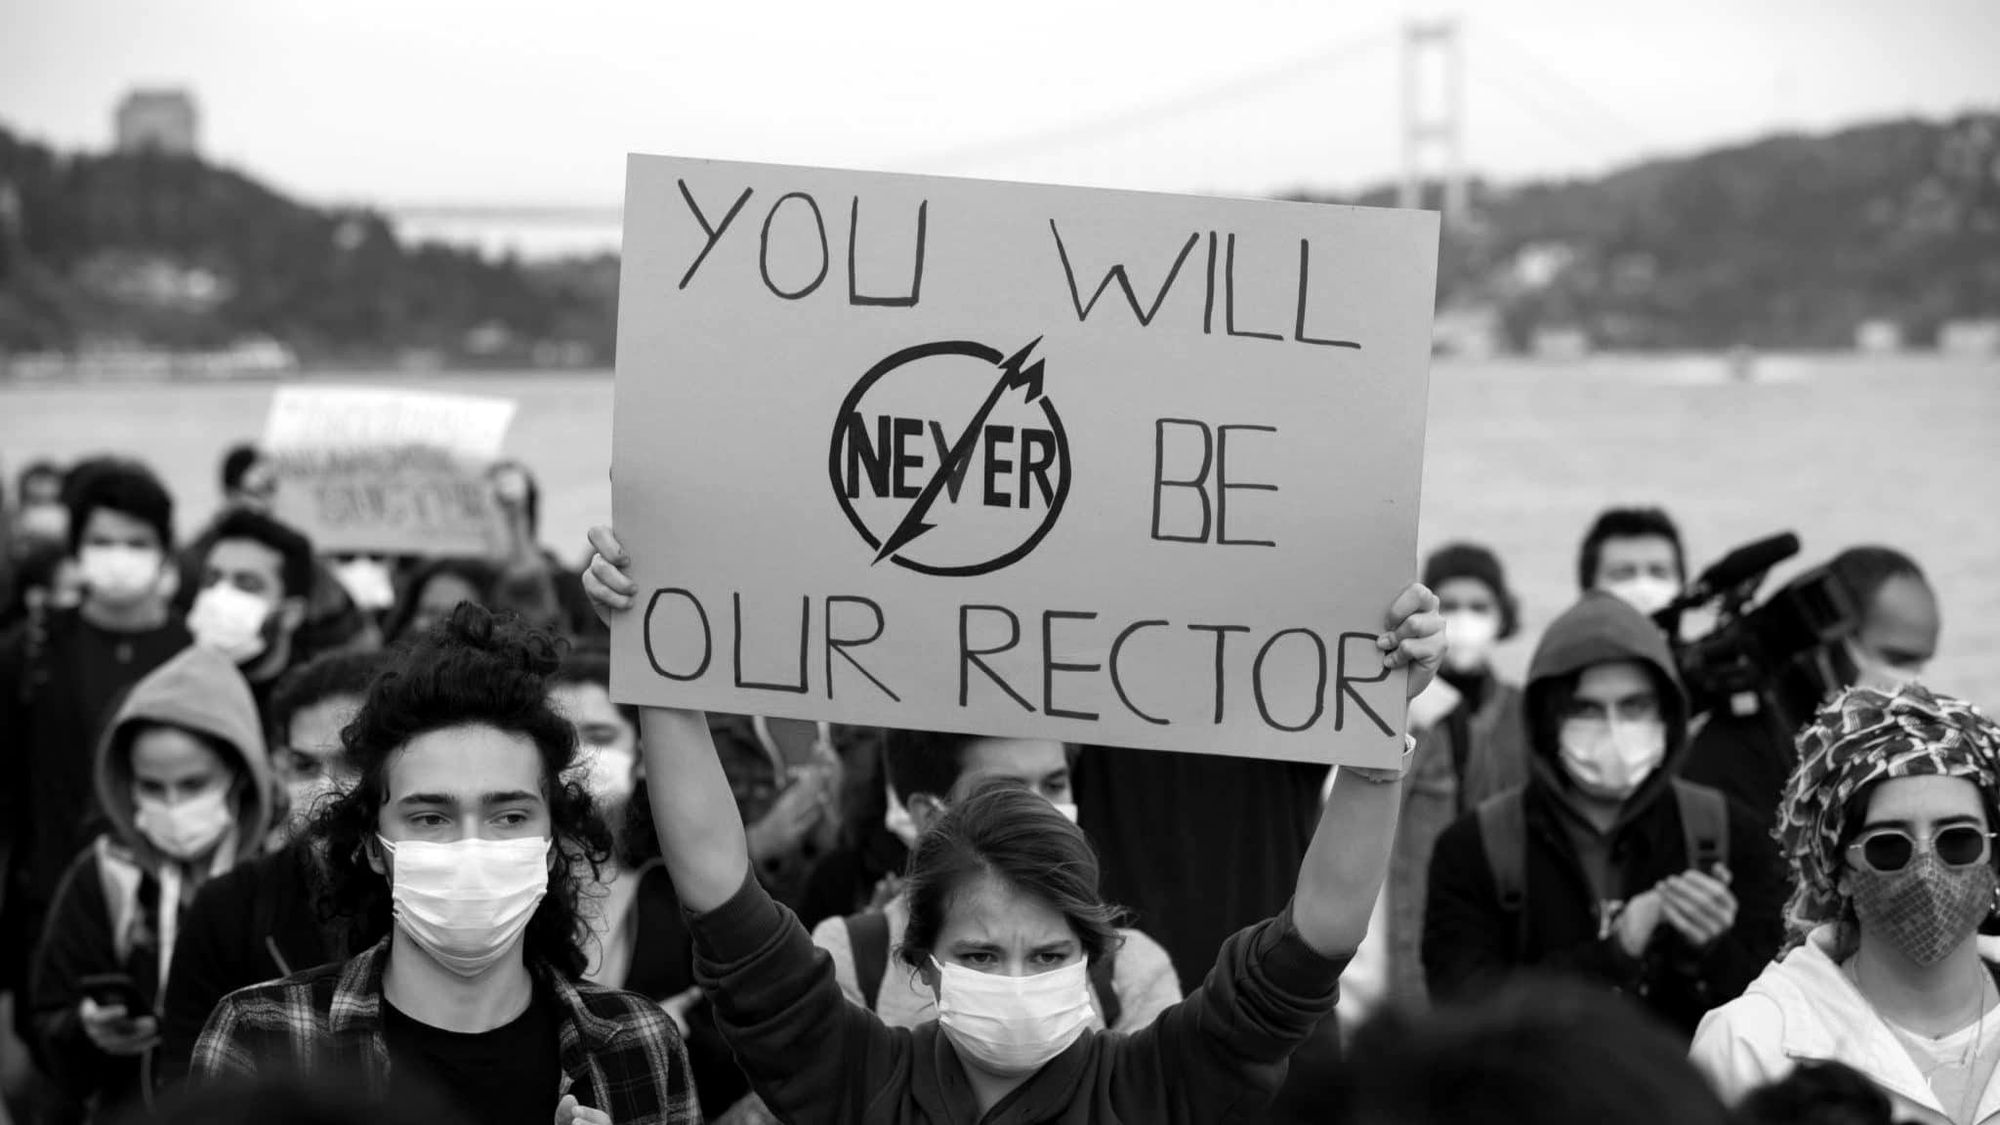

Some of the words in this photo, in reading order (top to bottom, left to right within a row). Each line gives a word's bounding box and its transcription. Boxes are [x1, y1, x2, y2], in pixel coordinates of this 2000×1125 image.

[678, 178, 929, 307] YOU
[1050, 218, 1362, 349] WILL
[846, 411, 1057, 510] NEVER
[1151, 418, 1279, 547] BE
[643, 587, 901, 702] OUR
[958, 604, 1397, 738] RECTOR
